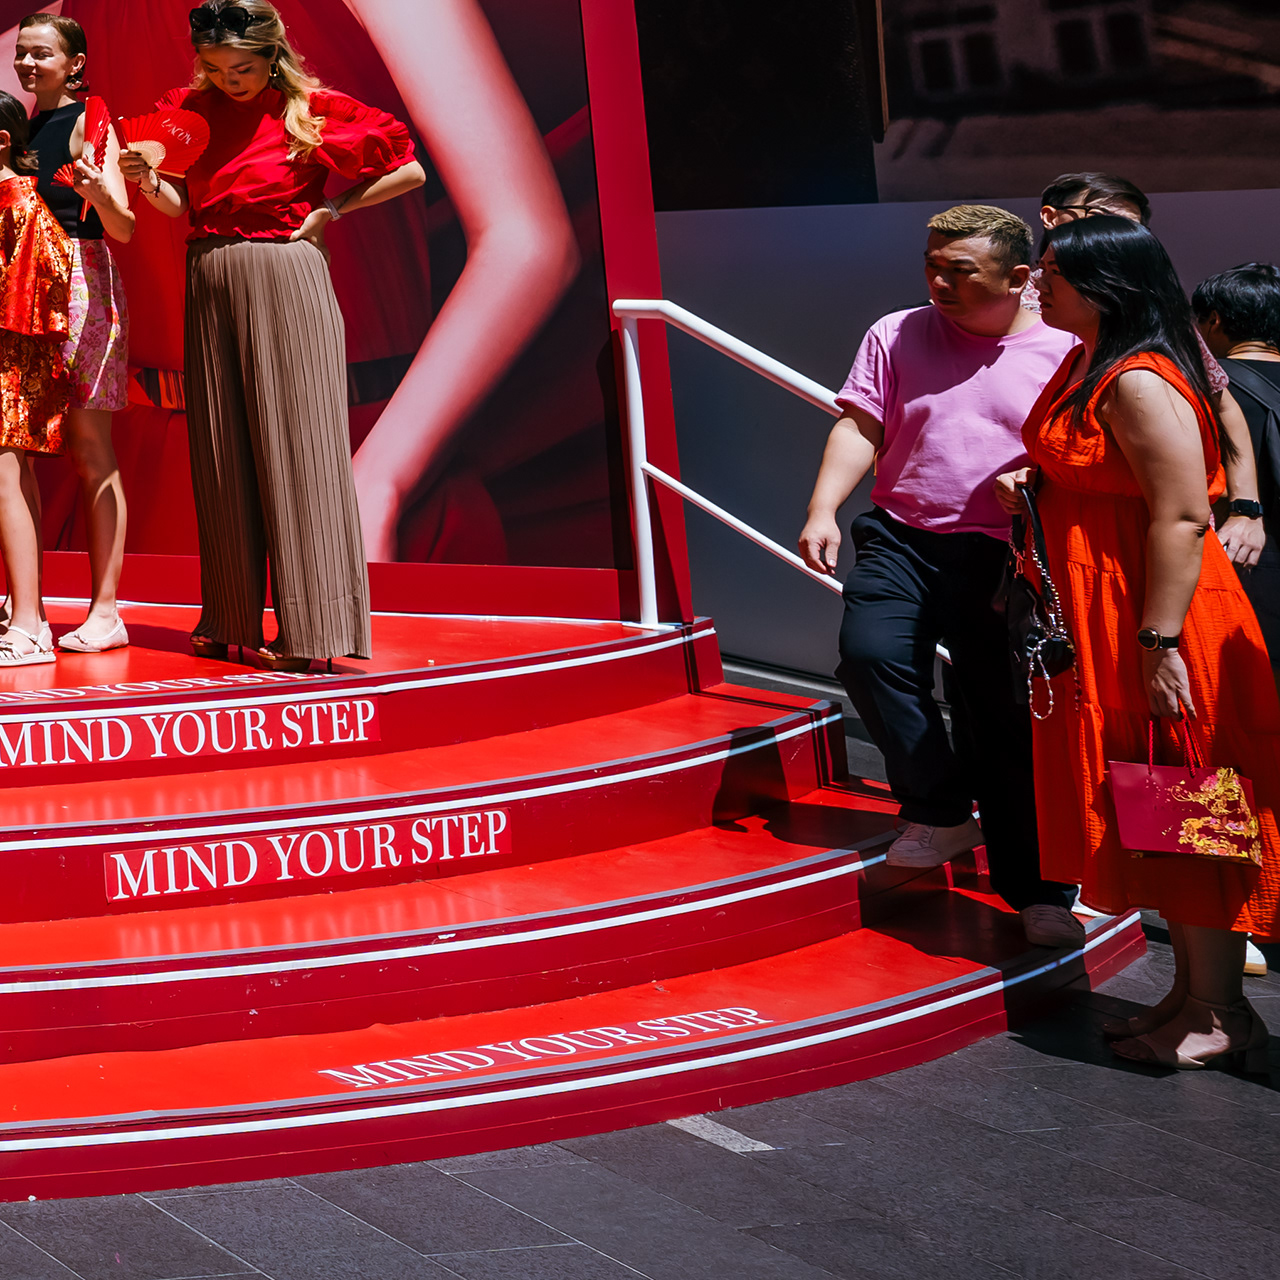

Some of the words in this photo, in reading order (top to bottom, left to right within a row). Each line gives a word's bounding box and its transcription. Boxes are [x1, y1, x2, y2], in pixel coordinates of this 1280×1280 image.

[84, 675, 233, 695] YOUR
[140, 707, 273, 758] YOUR
[280, 699, 375, 749] STEP
[110, 840, 259, 900] MIND
[266, 824, 402, 881] YOUR
[410, 810, 507, 864] STEP
[318, 1050, 495, 1088] MIND
[477, 1025, 656, 1062] YOUR
[638, 1006, 775, 1039] STEP
